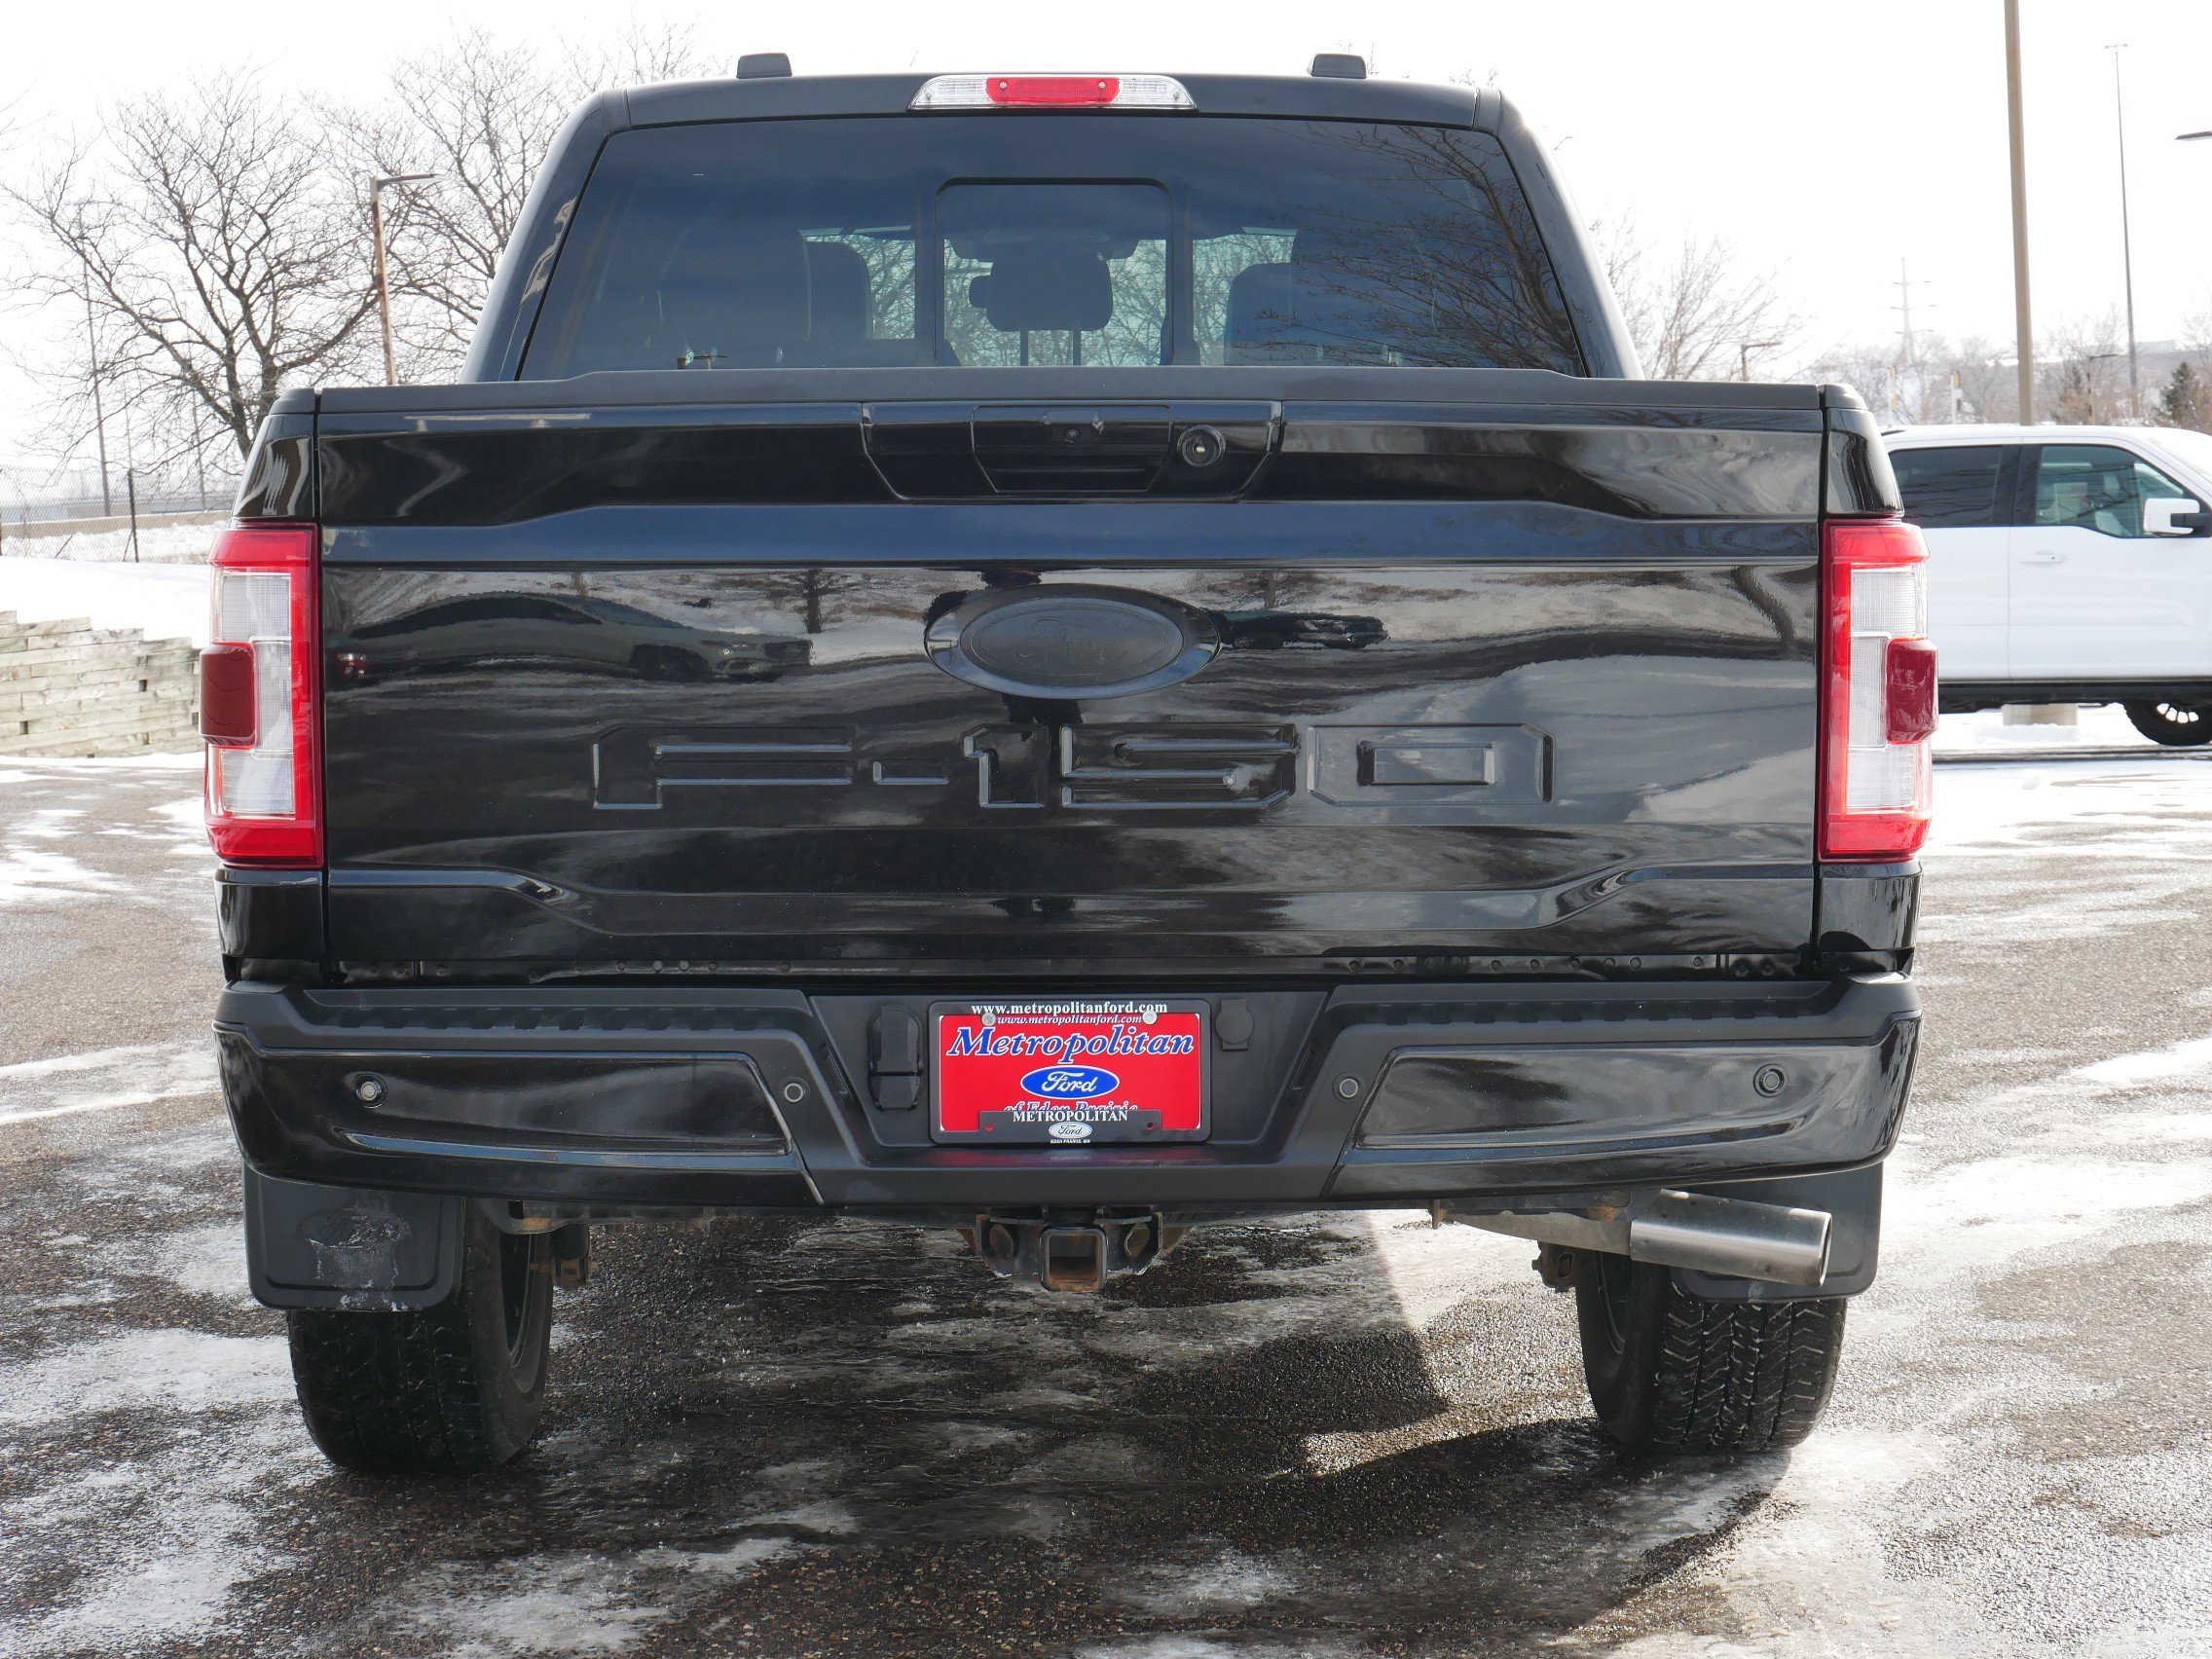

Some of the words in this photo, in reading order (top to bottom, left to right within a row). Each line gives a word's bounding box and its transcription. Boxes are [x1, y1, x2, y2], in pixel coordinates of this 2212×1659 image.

[591, 722, 1554, 809] F-150
[972, 1001, 1167, 1016] www.metropolitanford.com
[997, 1014, 1142, 1025] www.metropolitanford.com
[945, 1024, 1194, 1064] Metropolitan
[1041, 1070, 1098, 1092] Ford
[1013, 1111, 1128, 1122] METROPOLITAN
[1057, 1124, 1082, 1135] Ford
